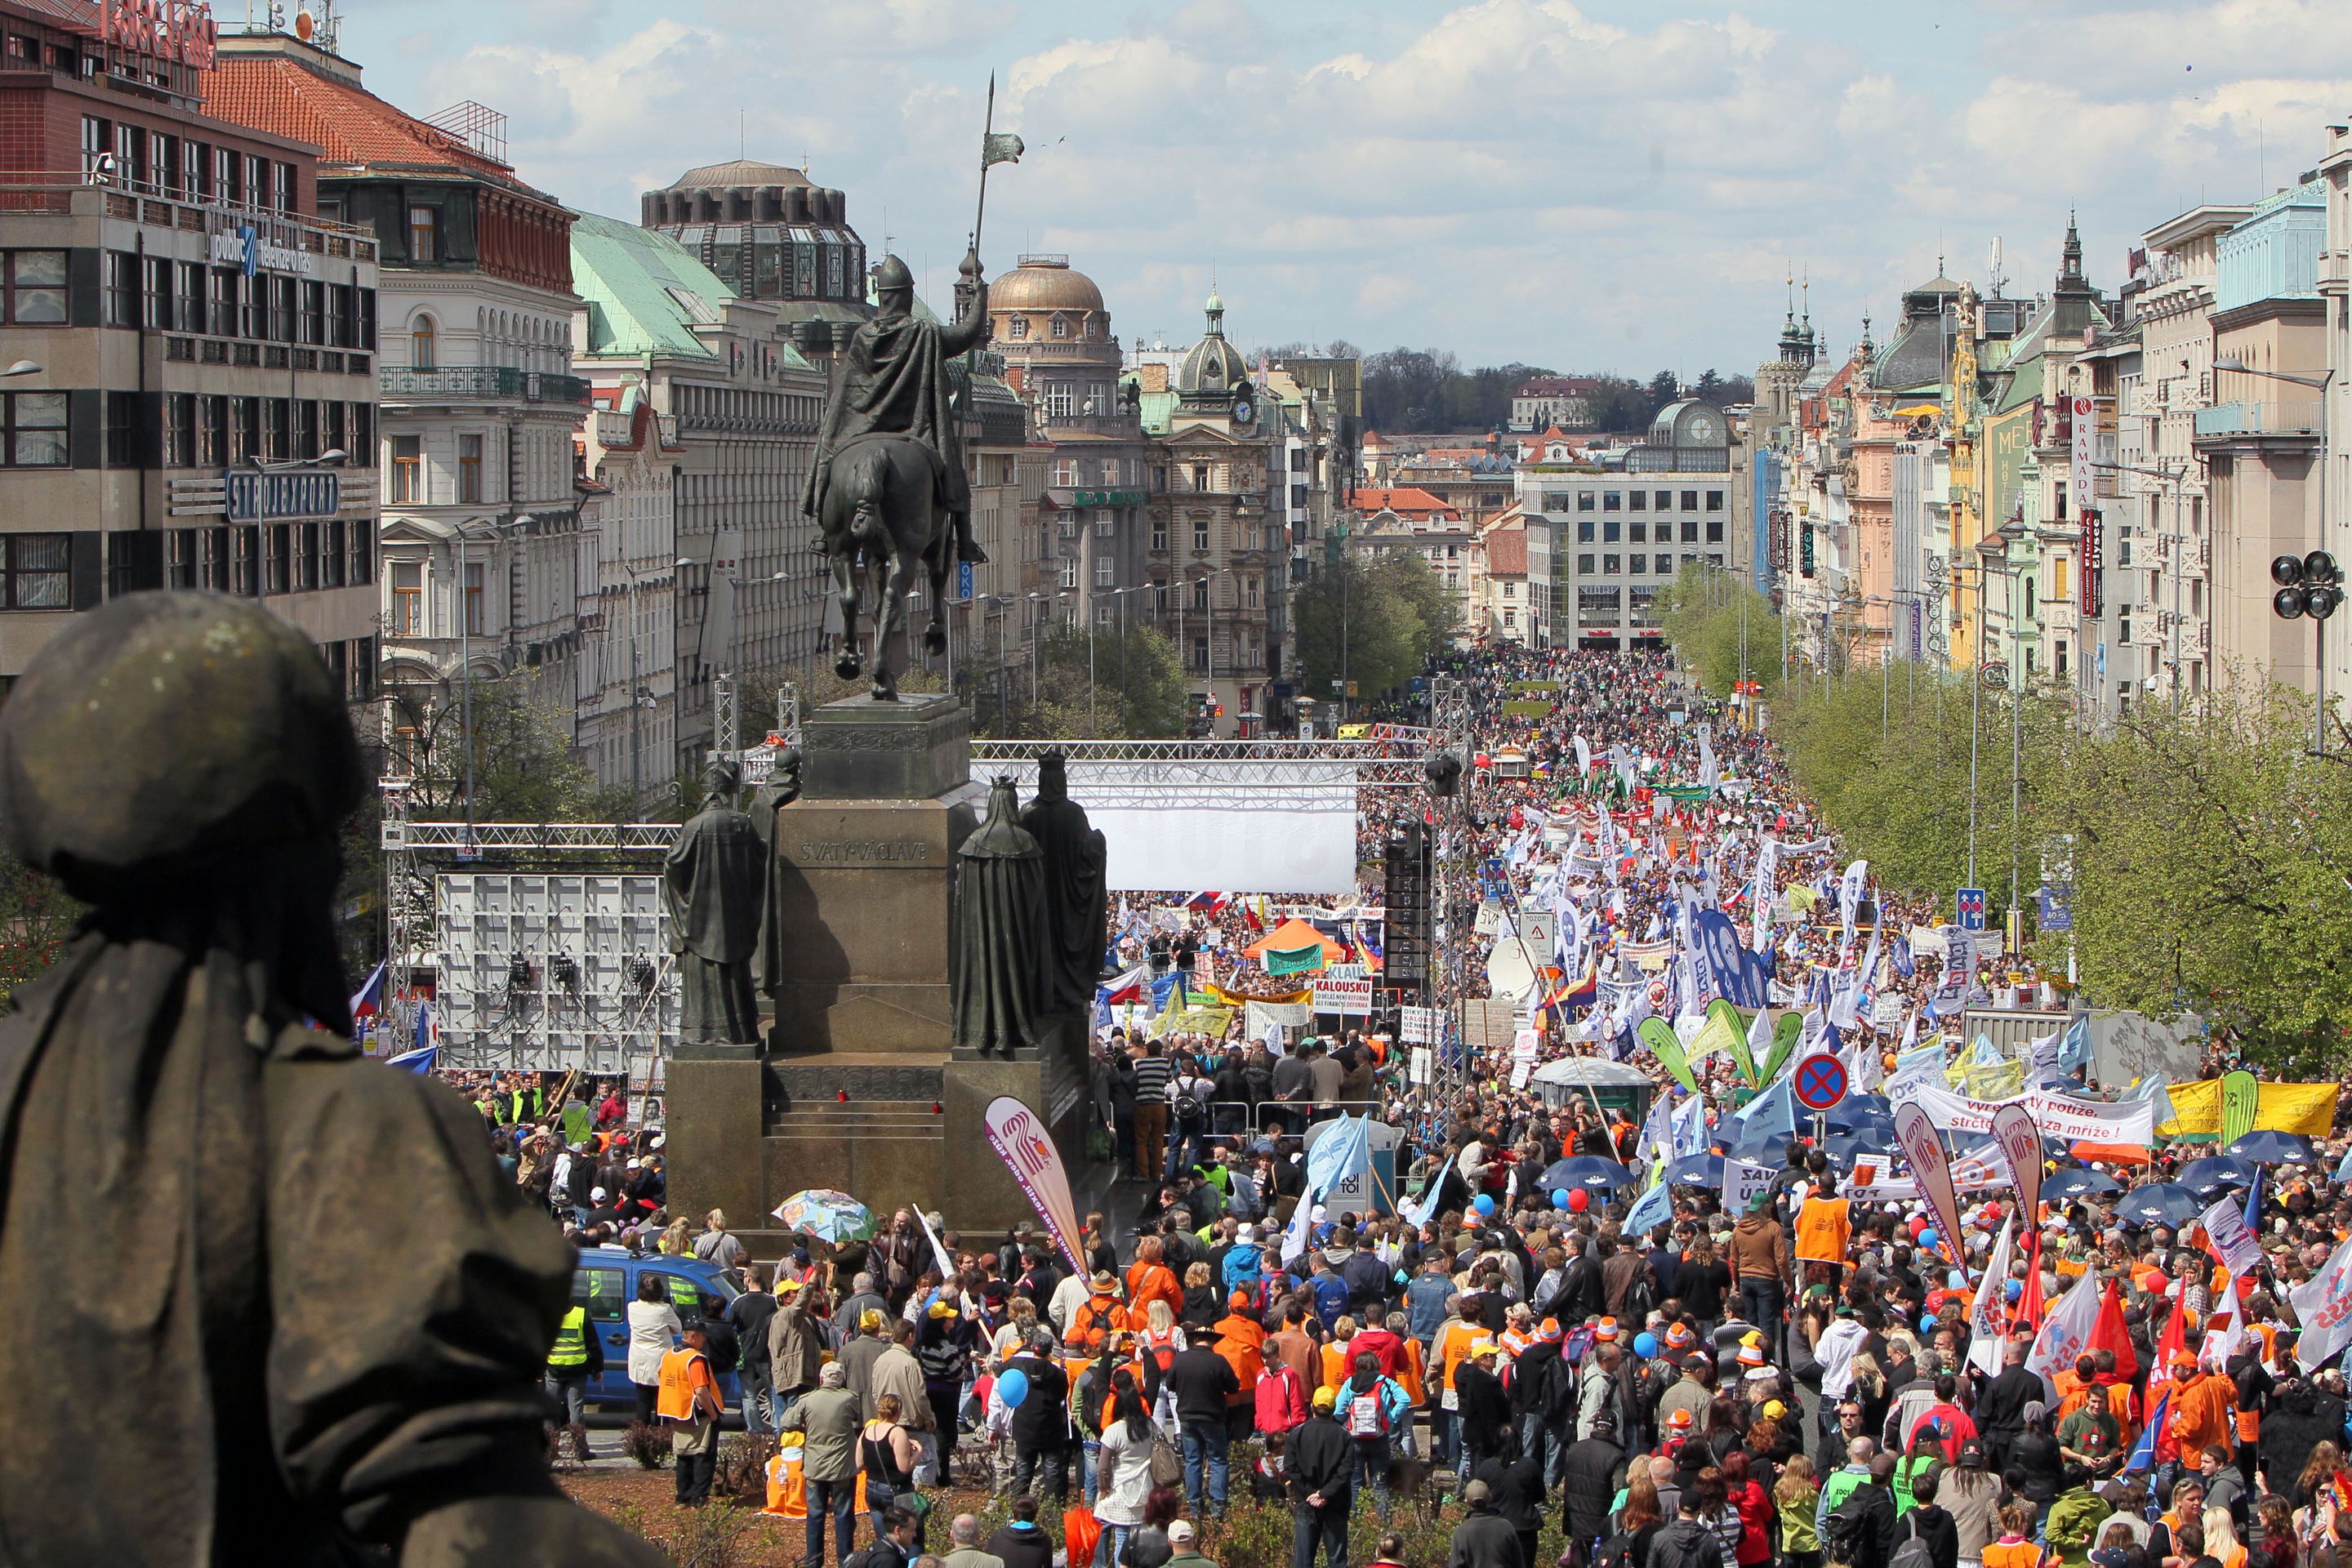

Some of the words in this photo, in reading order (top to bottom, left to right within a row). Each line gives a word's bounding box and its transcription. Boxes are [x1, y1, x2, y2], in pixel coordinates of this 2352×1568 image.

[211, 229, 246, 266] public
[2077, 424, 2088, 503] RAMADA
[233, 476, 334, 517] STROJEXPORT
[1803, 532, 1812, 570] GATE
[2092, 519, 2101, 569] Elysee
[1316, 981, 1370, 993] KALOUSKU
[1321, 992, 1335, 1000] DĚLÁŠ
[1283, 1005, 1300, 1014] BEZ
[2030, 1096, 2042, 1110] ty
[2047, 1098, 2098, 1119] potíže,
[1950, 1115, 1992, 1129] strčte
[2043, 1120, 2062, 1132] za
[2066, 1120, 2111, 1138] mříže
[2114, 1126, 2120, 1138] !
[1340, 1184, 1360, 1194] TOI
